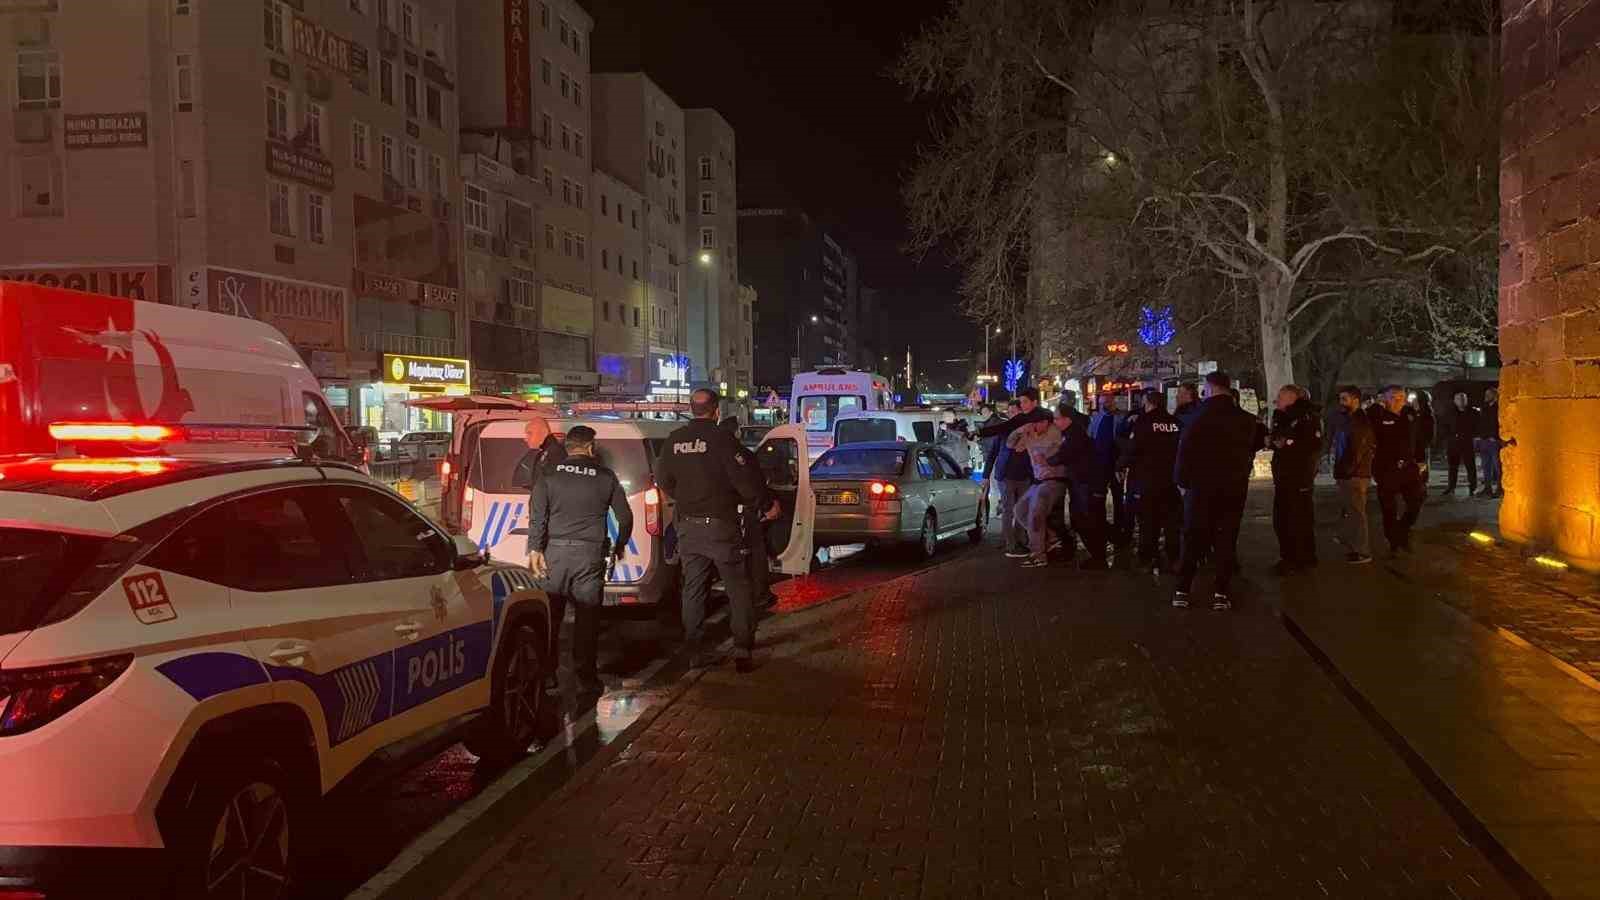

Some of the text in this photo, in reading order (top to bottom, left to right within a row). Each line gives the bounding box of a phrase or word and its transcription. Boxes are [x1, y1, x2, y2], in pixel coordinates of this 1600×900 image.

[803, 383, 859, 393] AMBULANS
[128, 577, 164, 605] 112
[407, 633, 465, 695] POLİS
